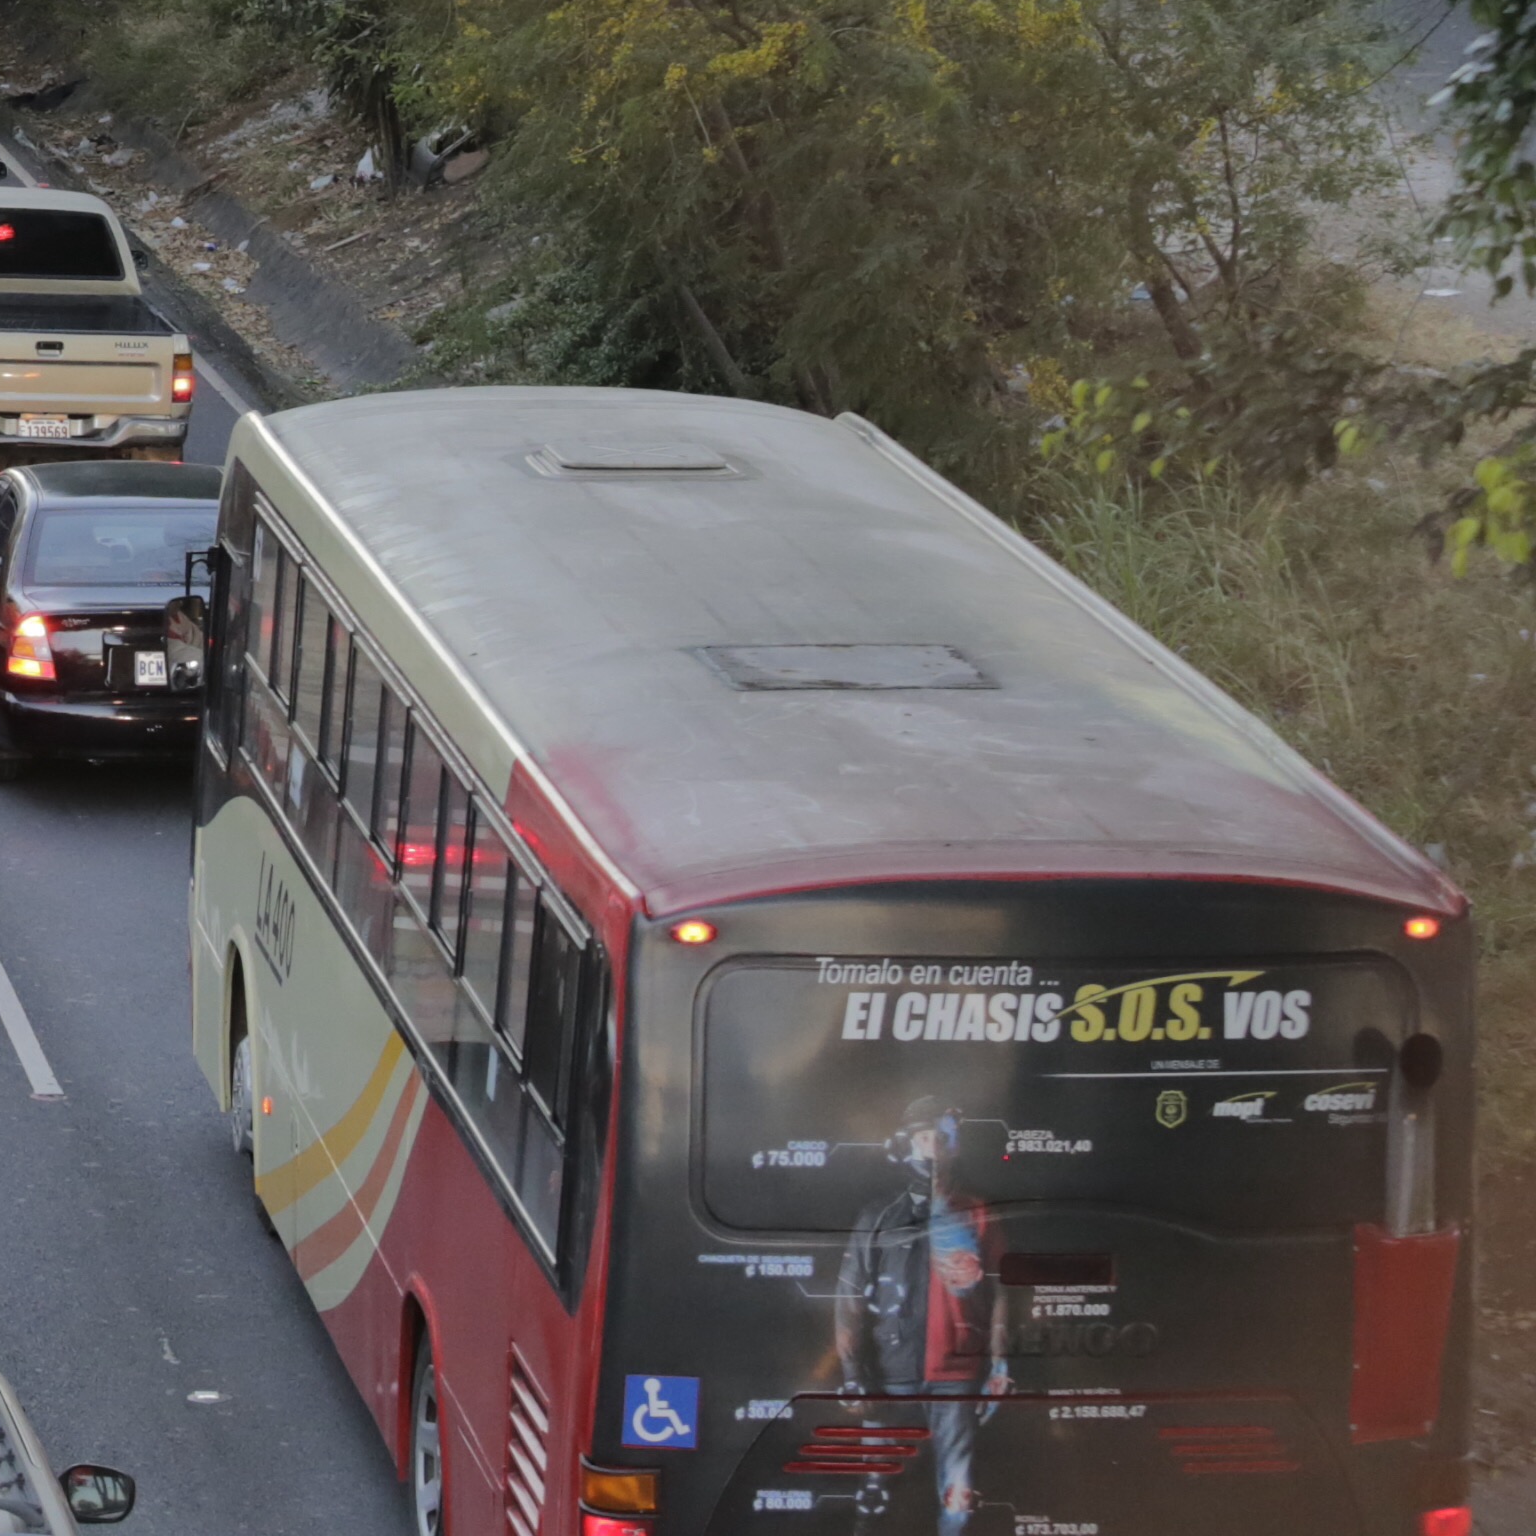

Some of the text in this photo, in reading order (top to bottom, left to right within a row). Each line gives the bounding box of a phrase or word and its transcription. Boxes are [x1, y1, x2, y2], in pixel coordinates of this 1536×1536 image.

[139, 660, 164, 676] BCN
[256, 849, 295, 979] LA 400
[815, 957, 903, 985] Tomalo
[909, 967, 941, 985] en
[948, 960, 1033, 986] cuenta
[841, 983, 1312, 1043] El CHASIS S.O.S. VOS
[1213, 1097, 1265, 1120] mopt
[1304, 1088, 1377, 1111] cosevi
[1008, 1130, 1055, 1140] CABEZA
[768, 1151, 826, 1166] 75.000
[758, 1264, 814, 1276] 150.000
